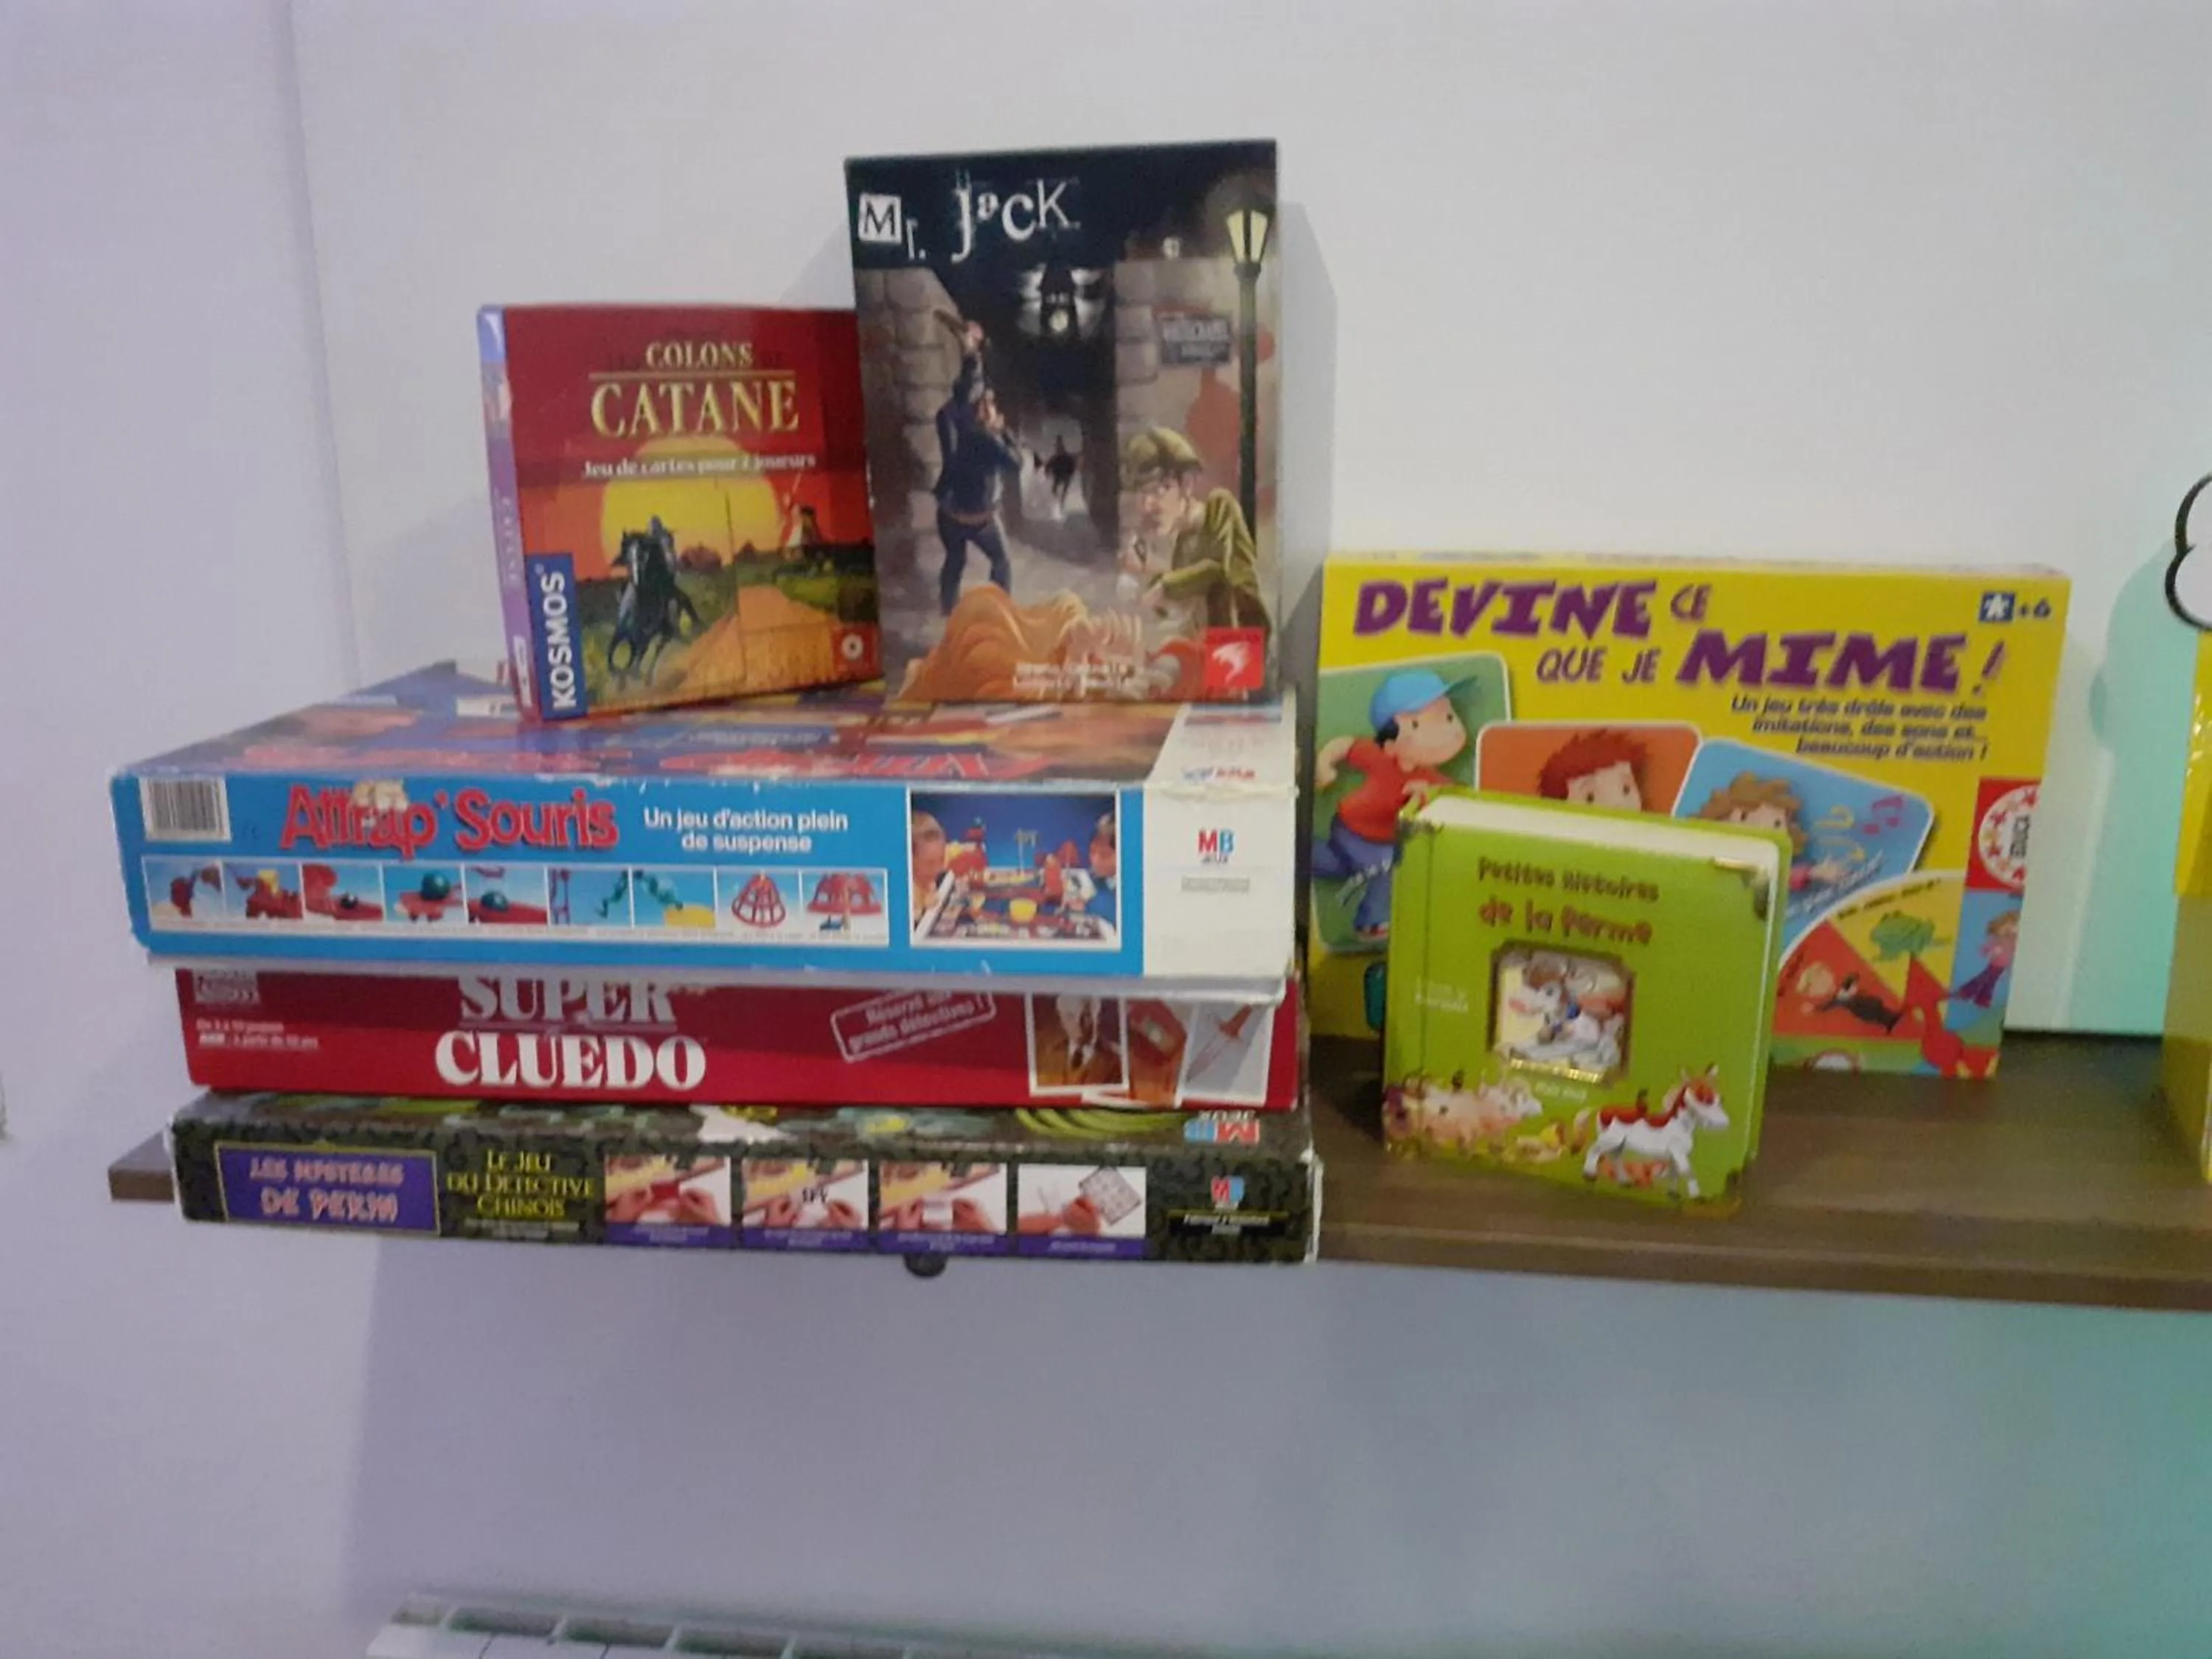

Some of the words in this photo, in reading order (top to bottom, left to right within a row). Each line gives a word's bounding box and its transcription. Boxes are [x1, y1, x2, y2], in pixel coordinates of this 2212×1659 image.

[646, 340, 754, 368] COLONS
[591, 379, 799, 437] CATANE
[616, 457, 636, 476] de
[1354, 577, 1658, 640] DEVINE
[1671, 585, 1711, 621] CE
[540, 571, 577, 709] KOSMOS
[1536, 646, 1607, 684] QUE
[1622, 649, 1659, 684] JE
[1675, 629, 1966, 692] MIME
[1731, 695, 1757, 714] Un
[1761, 697, 1792, 716] jeu
[643, 807, 672, 829] Un
[676, 807, 708, 834] jeu
[712, 807, 793, 831] d'action
[797, 808, 849, 835] plein
[681, 830, 709, 851] de
[712, 834, 813, 855] suspense
[1198, 828, 1234, 855] MB
[457, 978, 677, 1023] SUPER
[435, 1030, 707, 1091] CLUEDO
[515, 1149, 552, 1174] JEU
[260, 1186, 300, 1215] DE
[476, 1195, 566, 1218] CHINOIS
